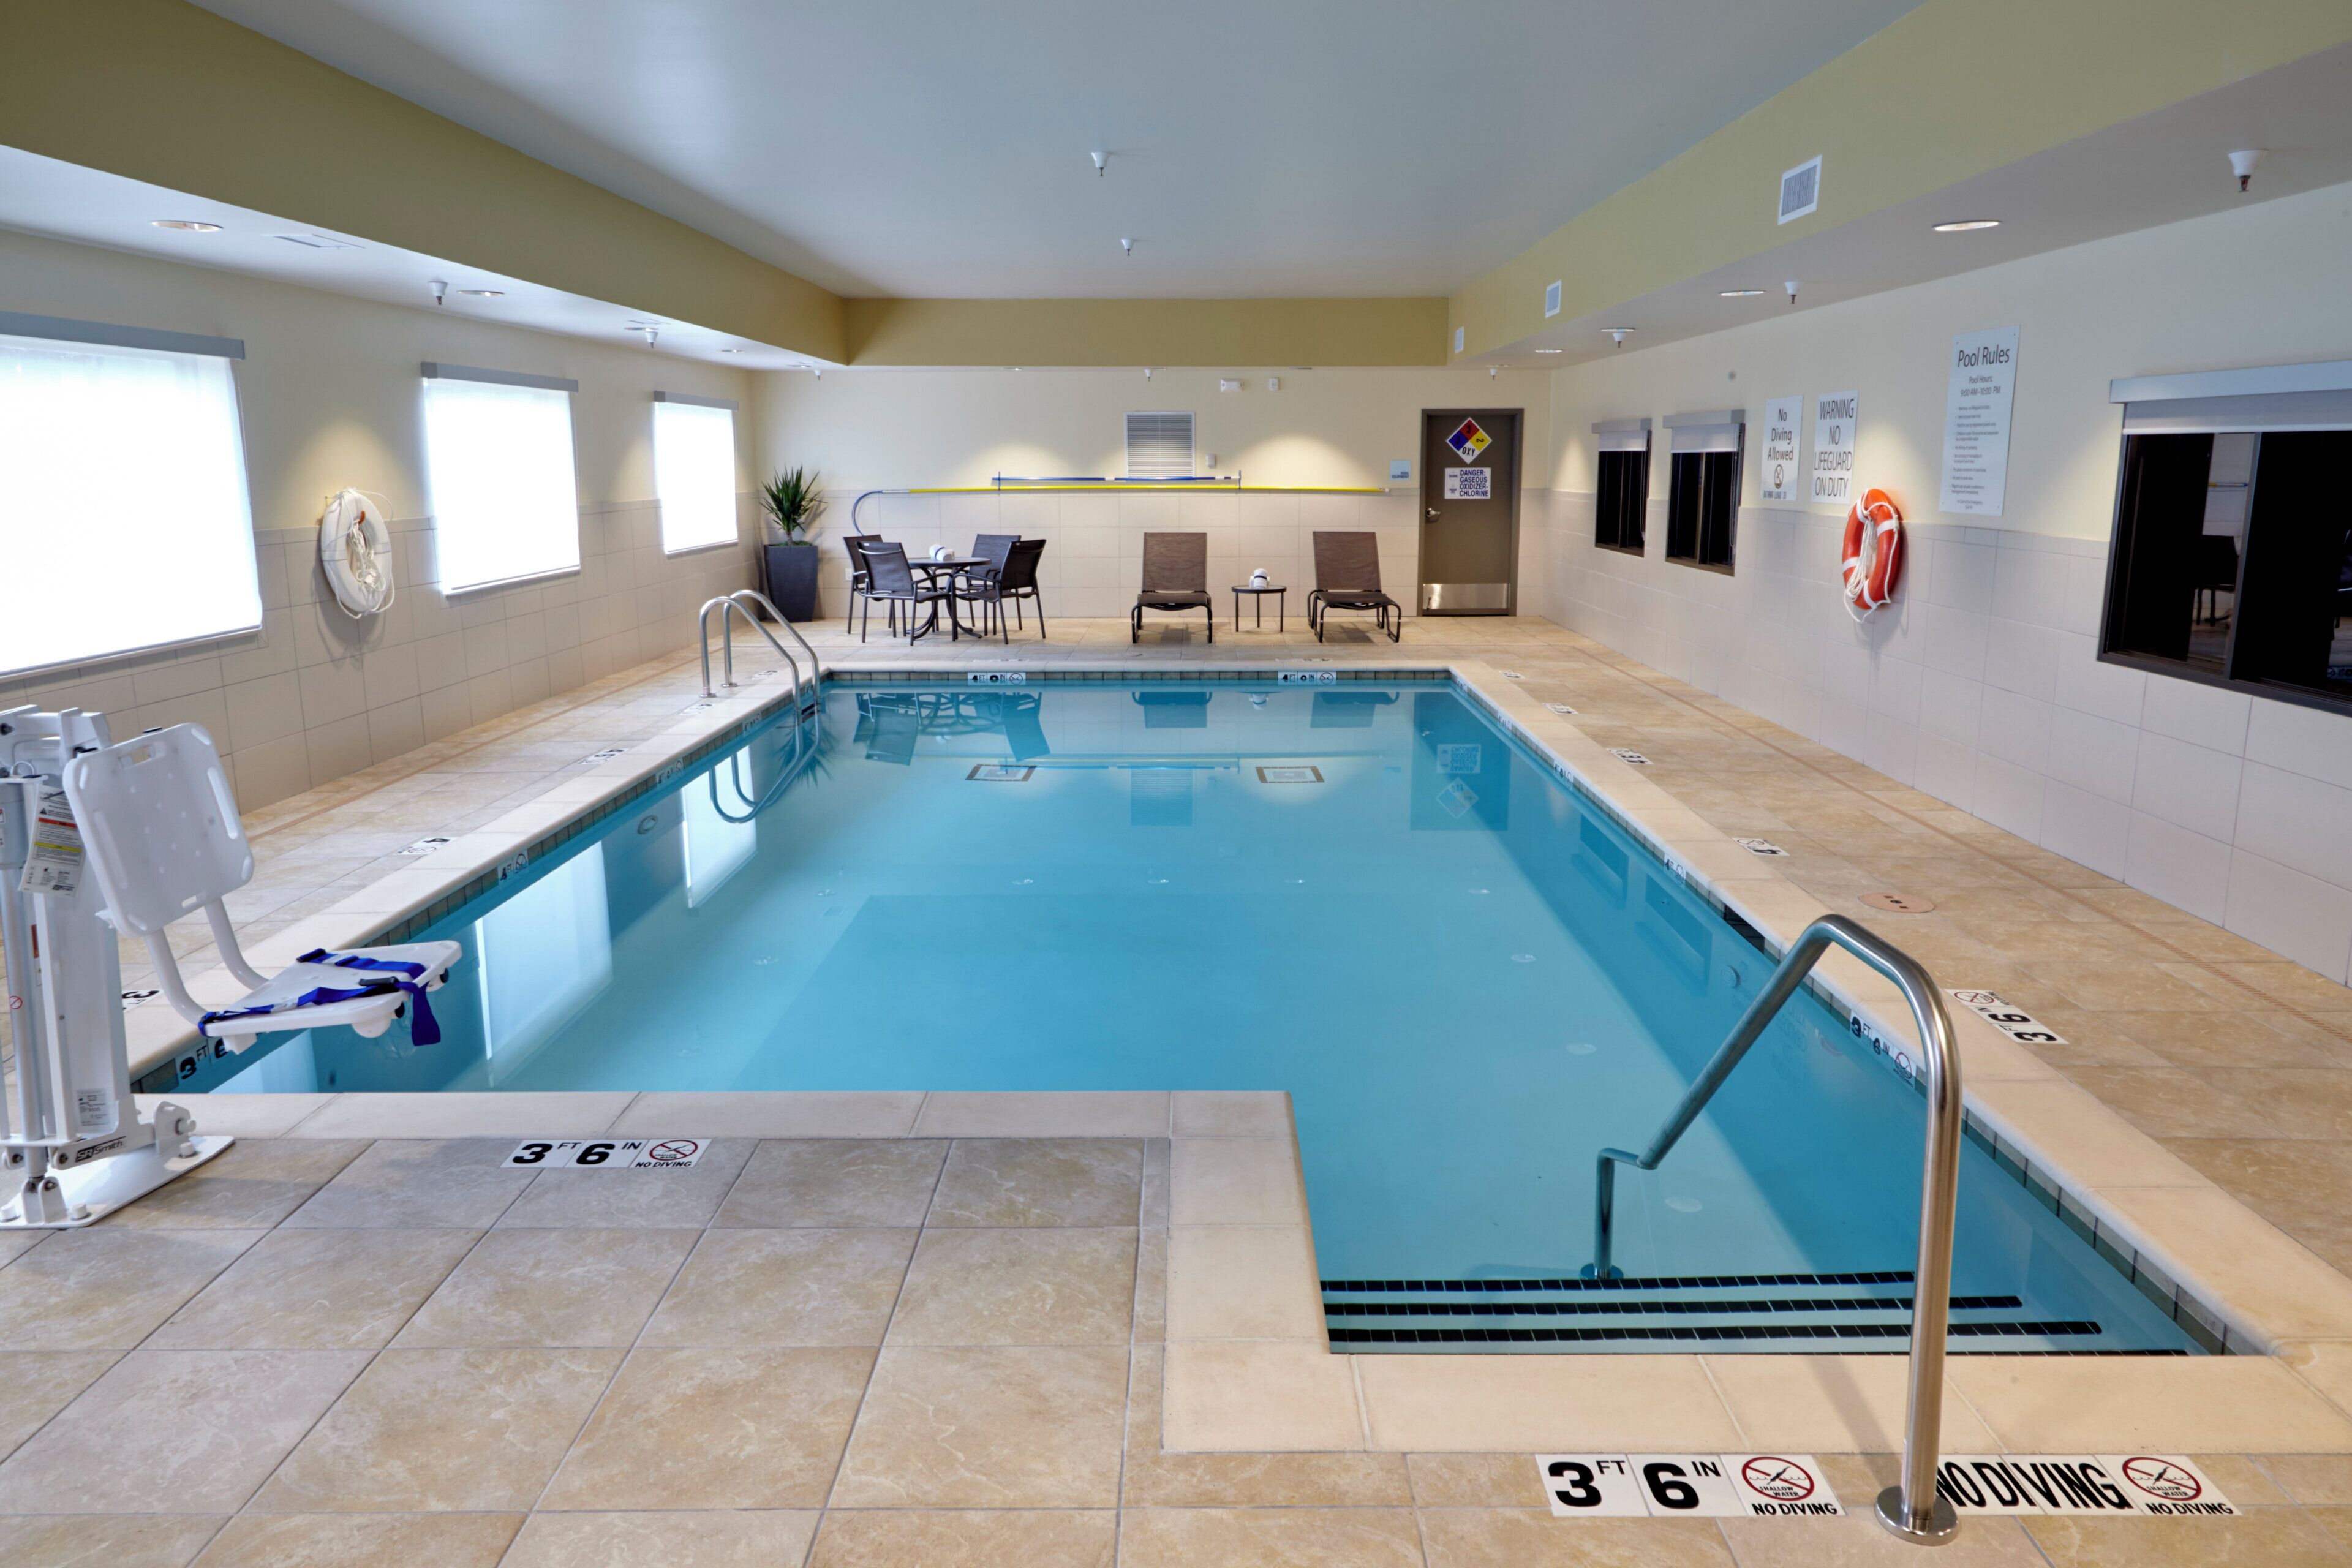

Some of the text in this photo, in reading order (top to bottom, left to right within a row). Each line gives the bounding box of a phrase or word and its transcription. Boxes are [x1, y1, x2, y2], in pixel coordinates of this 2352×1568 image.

[1958, 344, 2010, 368] Pool Rules
[1969, 375, 1979, 384] Pool
[1778, 408, 1787, 422] No
[1820, 398, 1855, 420] WARNING
[1771, 428, 1792, 445] Diving
[1828, 426, 1841, 445] NO
[1462, 447, 1476, 456] OXY
[1768, 446, 1794, 461] Allowed
[1814, 451, 1853, 471] LIFEGUARD
[1815, 477, 1849, 497] ON DUTY
[1988, 1014, 2031, 1023] 6
[1852, 1016, 1861, 1038] 3
[1873, 1038, 1881, 1055] 6
[2013, 1031, 2057, 1042] 3
[180, 1057, 197, 1079] 3
[197, 1045, 208, 1061] FT
[513, 1143, 553, 1164] 3
[576, 1143, 616, 1165] 6
[1548, 1460, 1721, 1509] 3 FT 6 IN
[1970, 1462, 2135, 1509] DIVING
[1752, 1503, 1838, 1515] NO DIVING
[2145, 1502, 2234, 1515] NO DIVING
